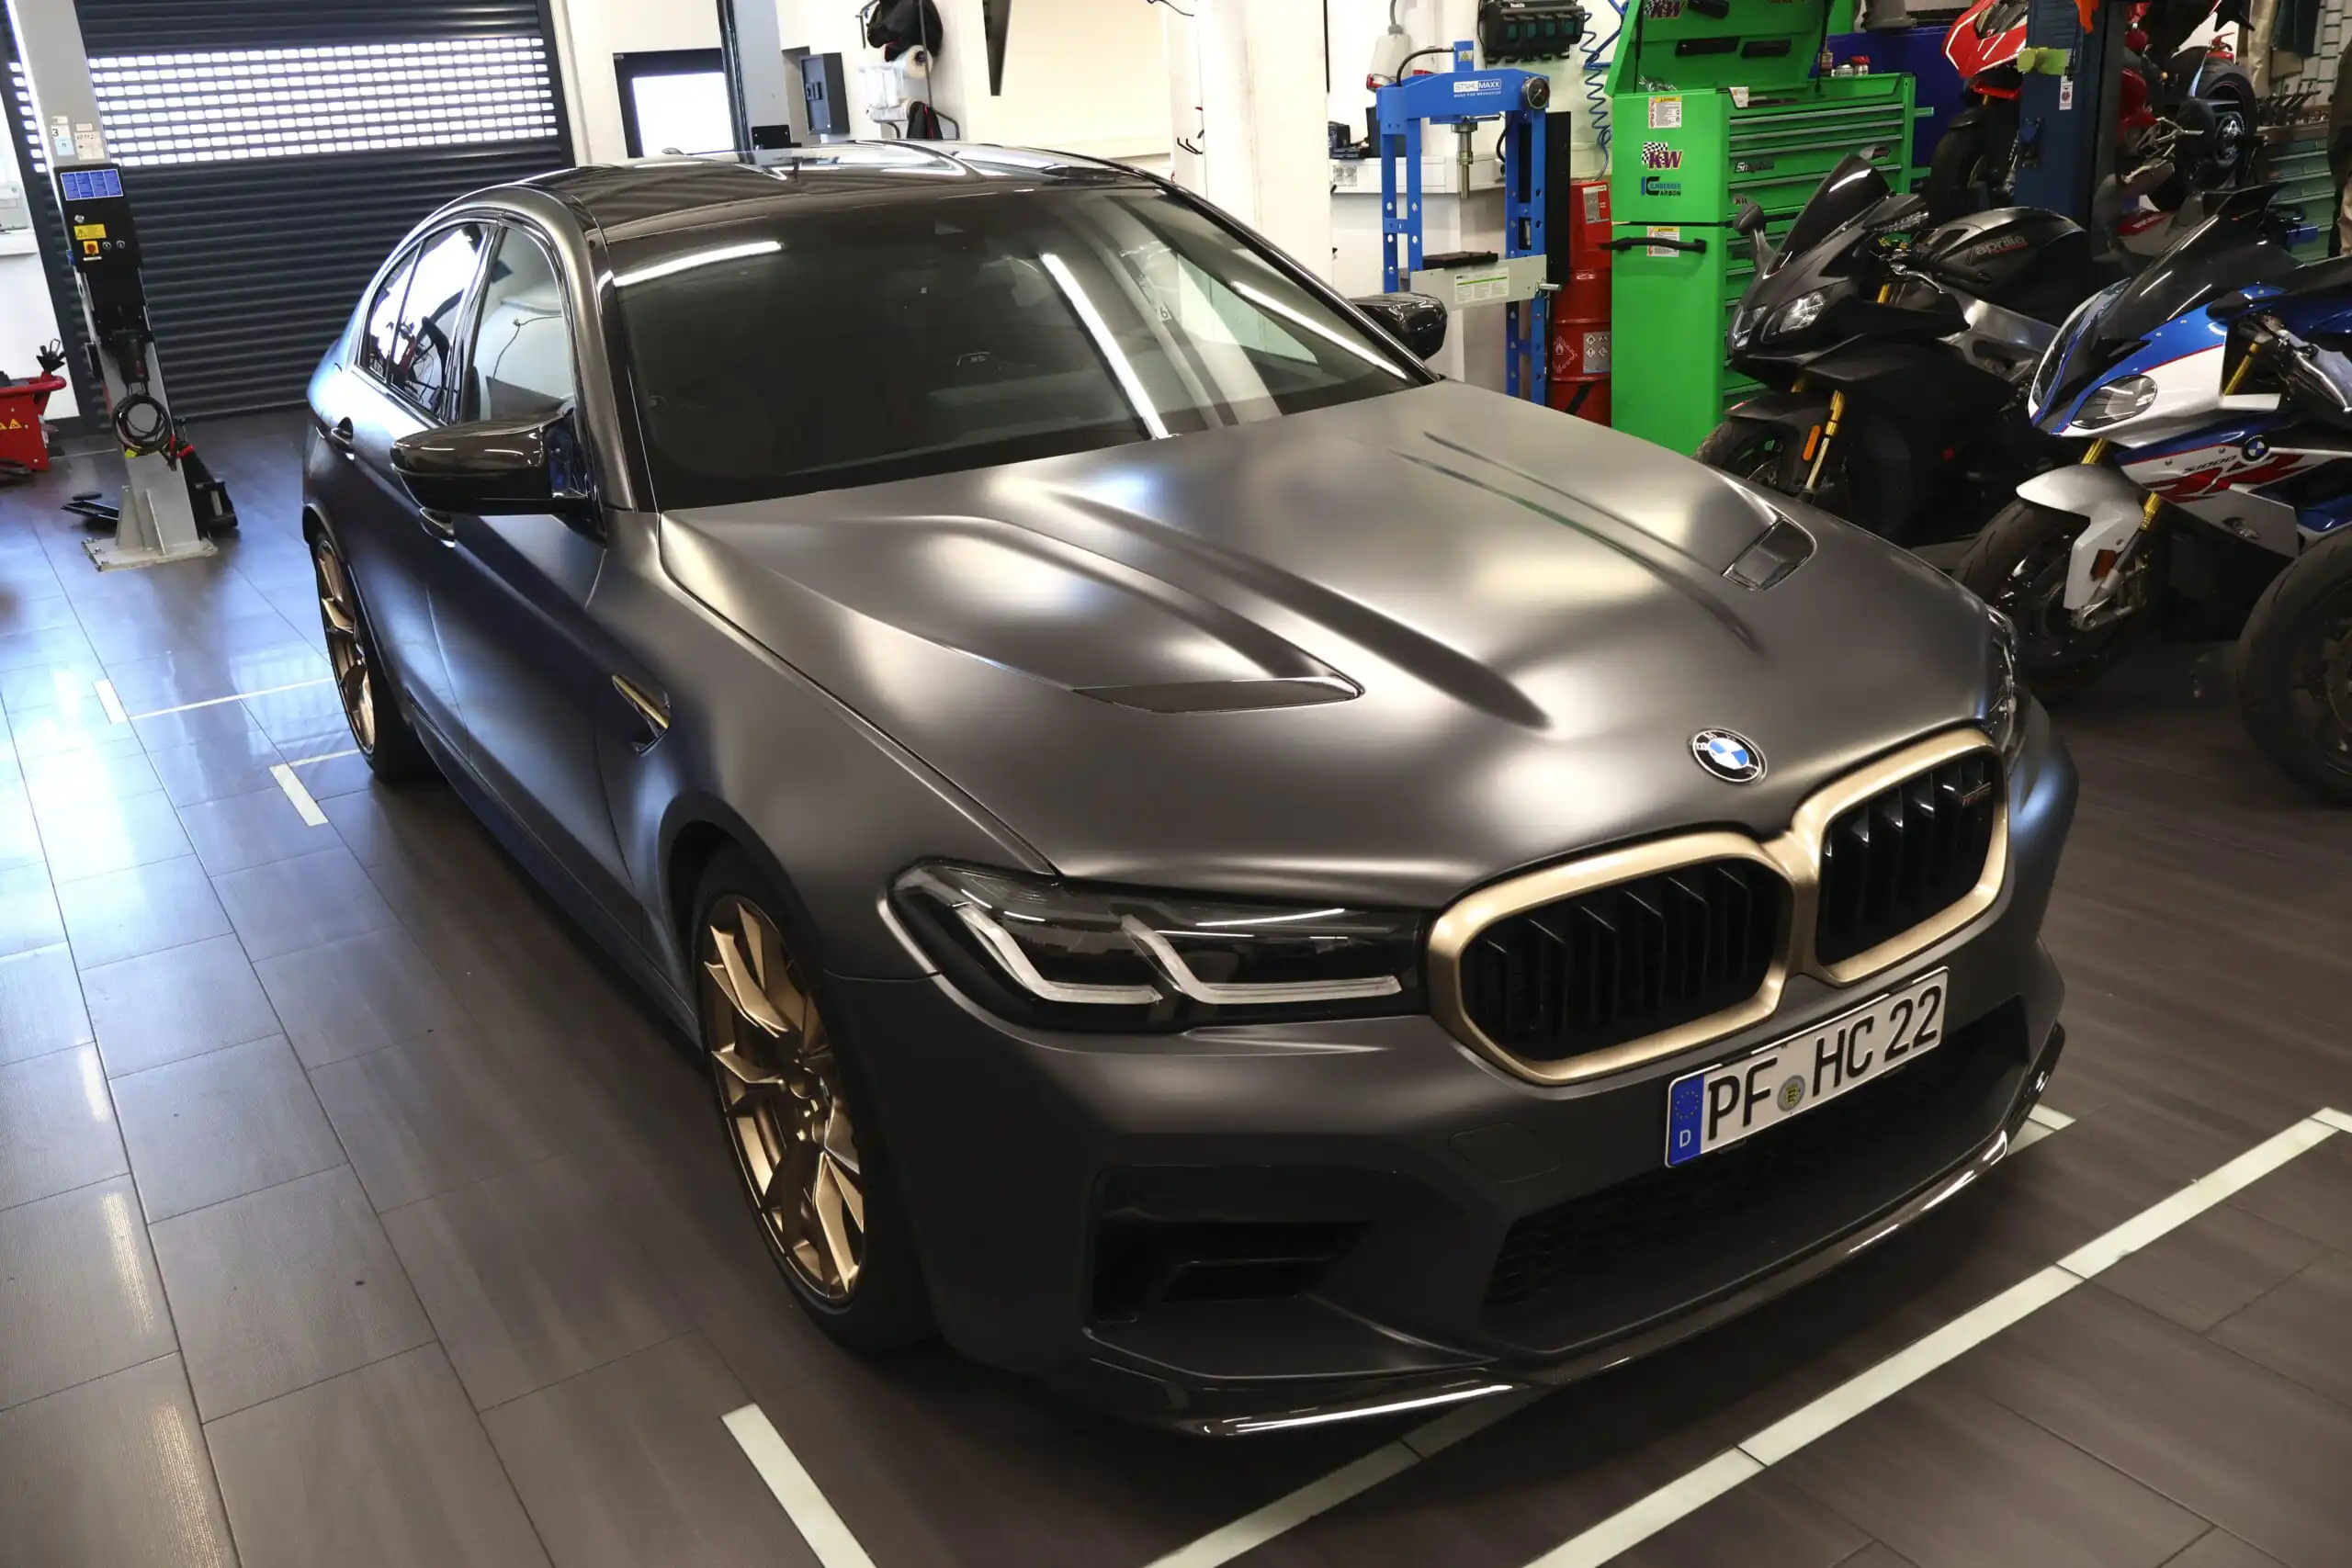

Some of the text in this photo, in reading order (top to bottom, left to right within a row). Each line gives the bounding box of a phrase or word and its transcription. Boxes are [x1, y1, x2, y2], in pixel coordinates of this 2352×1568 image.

[1649, 151, 1682, 169] KW
[1975, 235, 2025, 255] aprilia
[1708, 985, 1942, 1140] PF HC 22
[1679, 1129, 1691, 1148] D
